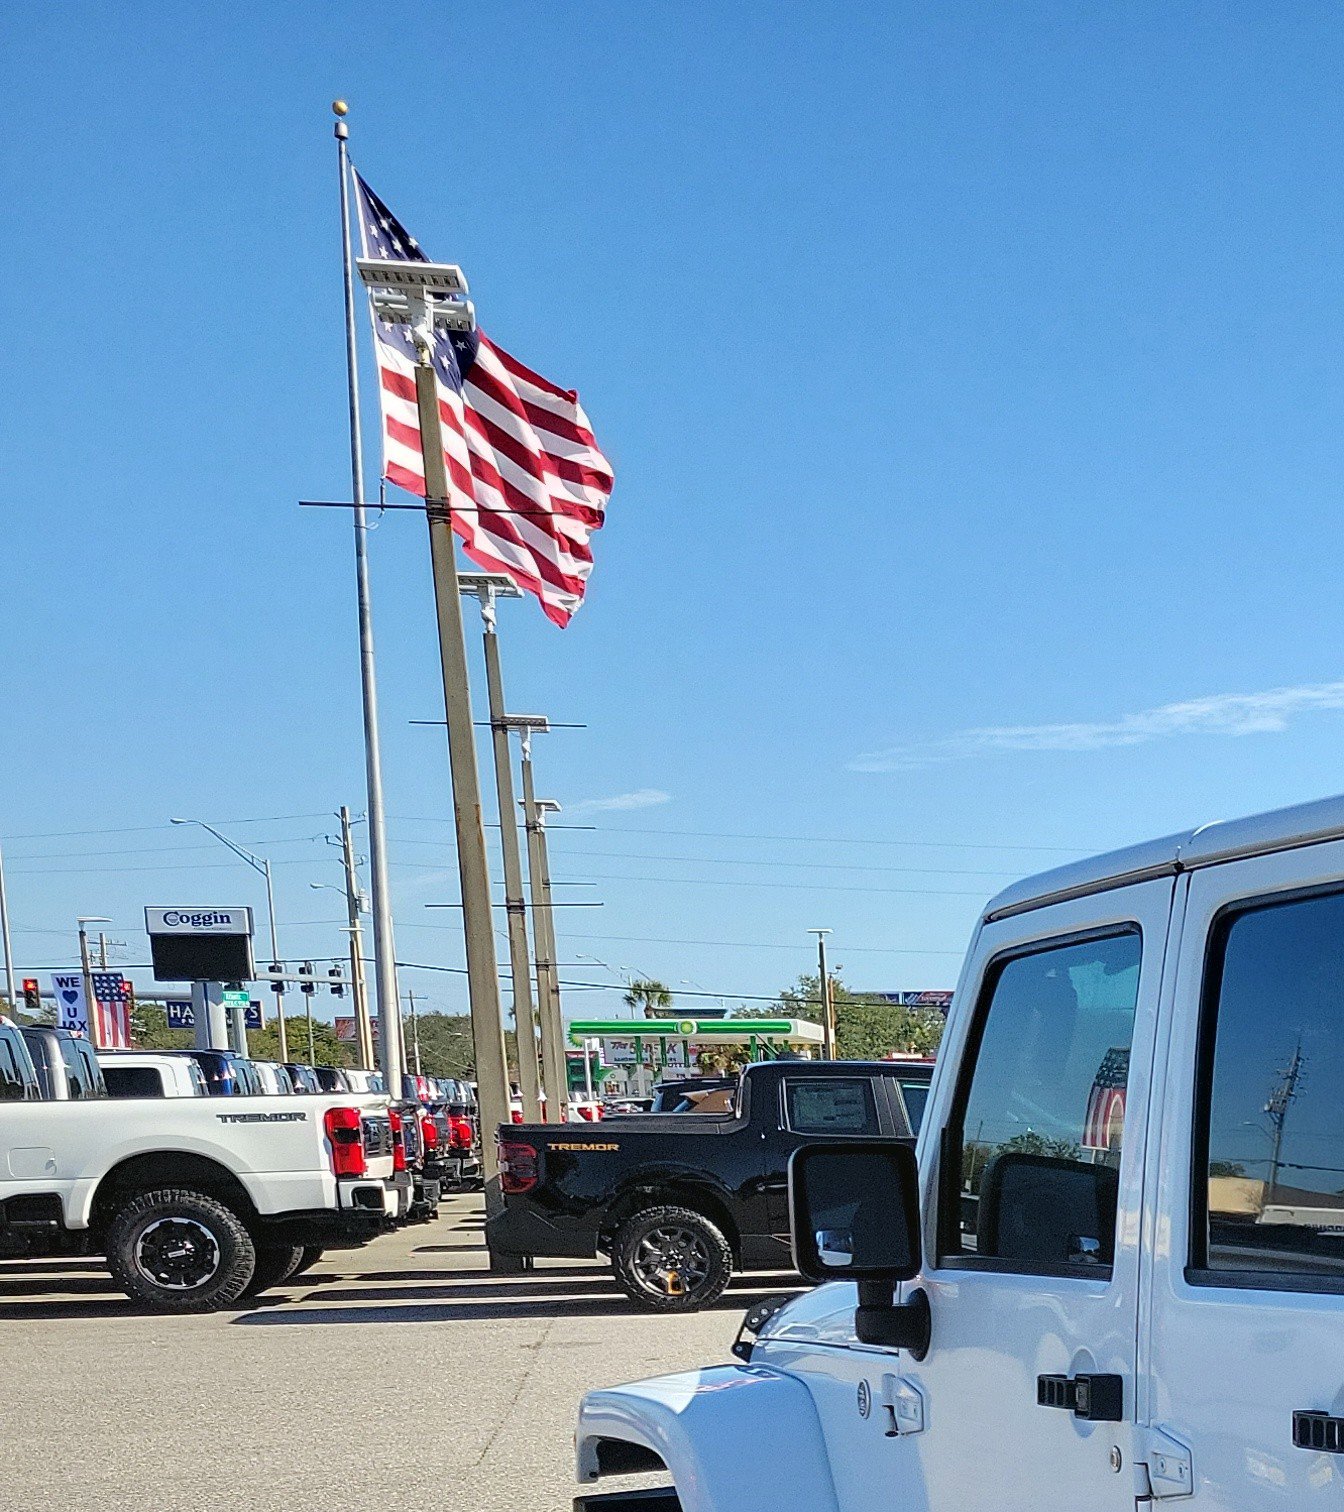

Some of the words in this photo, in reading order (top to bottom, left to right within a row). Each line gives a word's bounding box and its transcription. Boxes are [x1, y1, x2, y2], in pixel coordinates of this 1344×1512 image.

[163, 911, 231, 926] Coggin
[56, 977, 80, 987] WE
[67, 1007, 78, 1018] U
[62, 1020, 88, 1031] JAX
[216, 1112, 308, 1123] TREMOR
[547, 1143, 620, 1151] TREMOR
